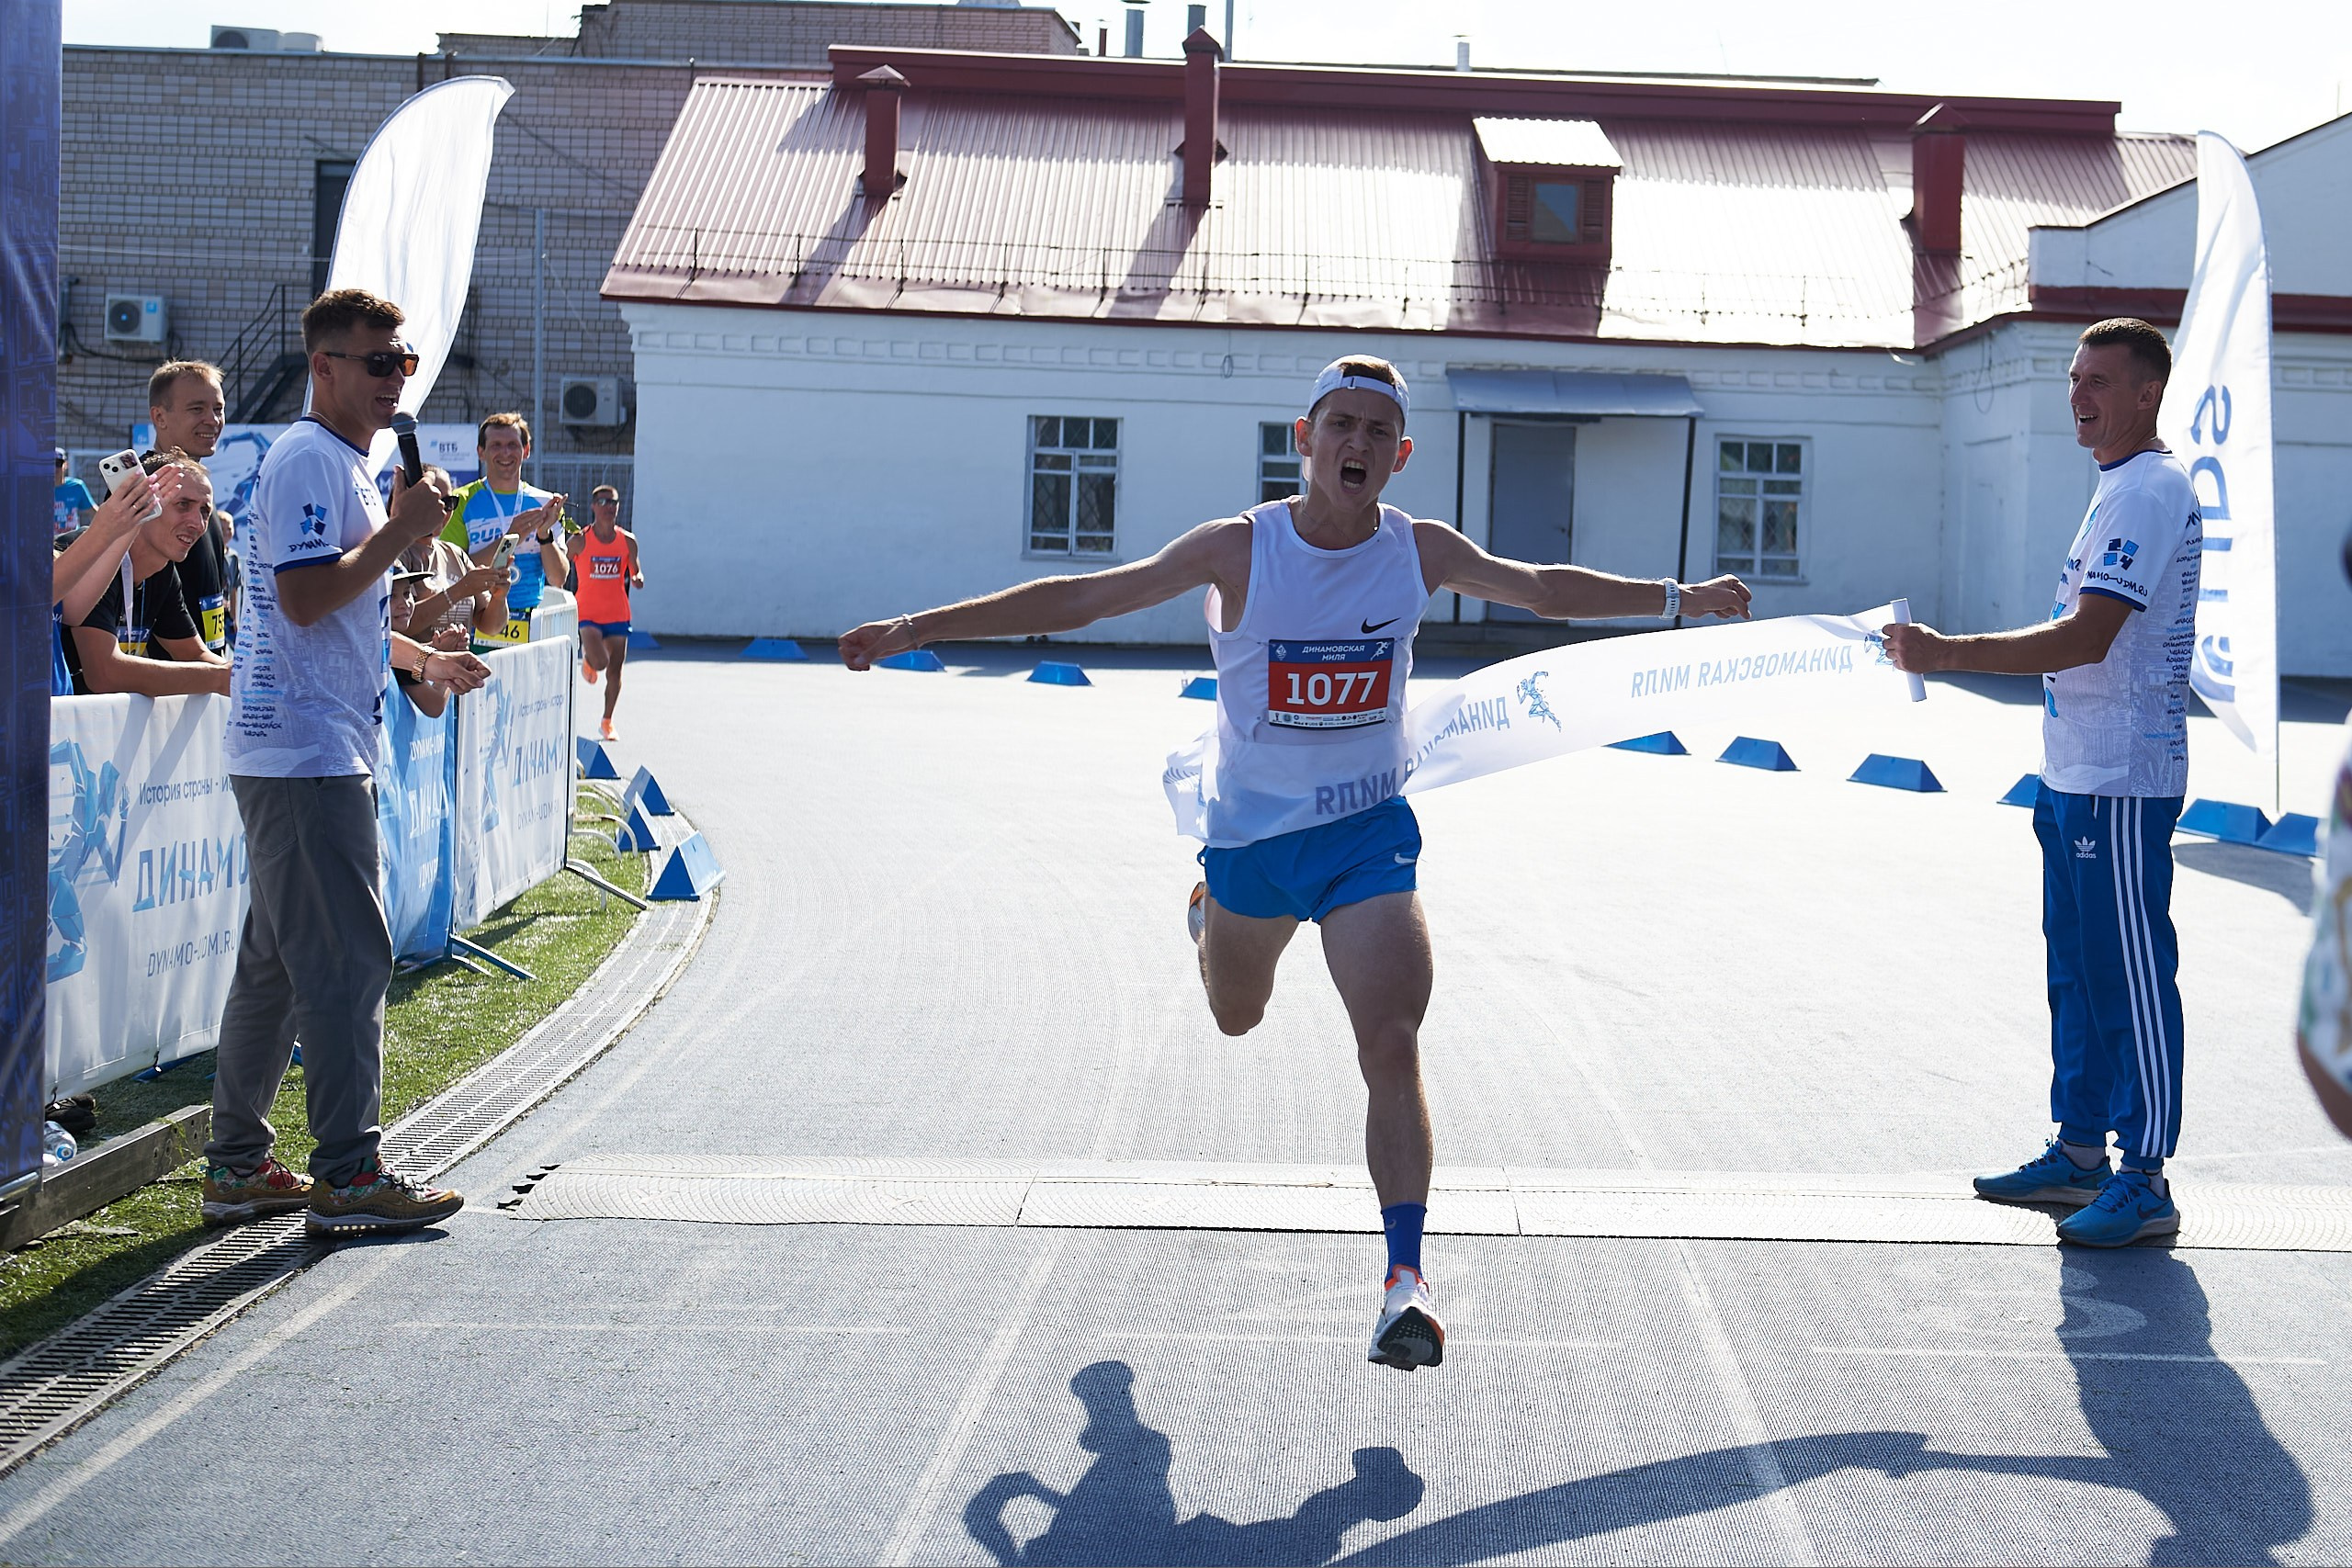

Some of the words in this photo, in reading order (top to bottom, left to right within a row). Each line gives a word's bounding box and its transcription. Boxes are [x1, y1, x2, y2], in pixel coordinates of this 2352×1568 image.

[439, 442, 458, 452] ВТБ
[288, 538, 329, 552] DYNAM
[594, 563, 618, 574] 1076
[500, 625, 520, 639] 46
[1302, 645, 1365, 654] ДИНАМОВСКАЯ
[1286, 671, 1378, 706] 1077
[139, 782, 181, 807] История
[183, 777, 213, 802] страны
[147, 929, 236, 977] DYNAMO-UDM.RU
